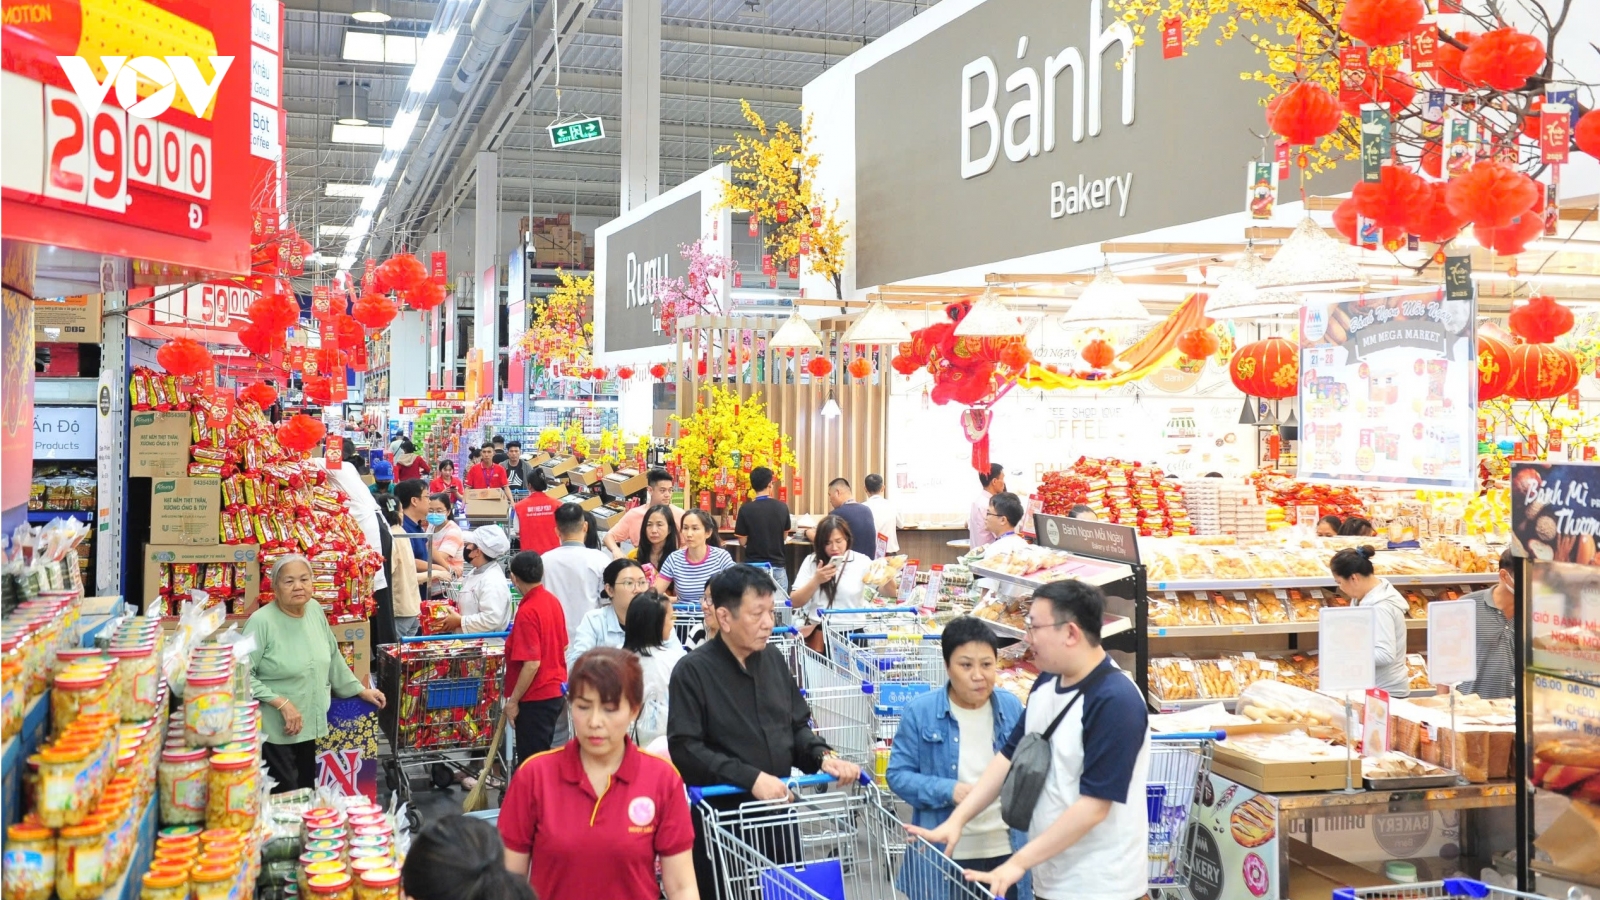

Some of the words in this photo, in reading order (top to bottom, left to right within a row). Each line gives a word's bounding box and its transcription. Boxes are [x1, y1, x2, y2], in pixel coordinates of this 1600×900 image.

[254, 81, 270, 97] Good
[961, 0, 1136, 179] Bánh
[253, 112, 270, 133] Bột
[251, 133, 270, 149] offee
[1051, 172, 1133, 219] Bakery
[1362, 334, 1377, 347] MM
[1378, 329, 1402, 343] MEGA
[1404, 329, 1440, 343] MARKET
[1072, 408, 1096, 418] SHOP
[57, 419, 80, 435] Độ
[35, 441, 80, 450] Products
[1524, 478, 1563, 506] Bánh
[1565, 480, 1589, 508] Mì
[1061, 523, 1078, 536] Bánh
[1077, 526, 1095, 541] Ngon
[1094, 527, 1106, 541] Mỗi
[1107, 530, 1124, 547] Ngày
